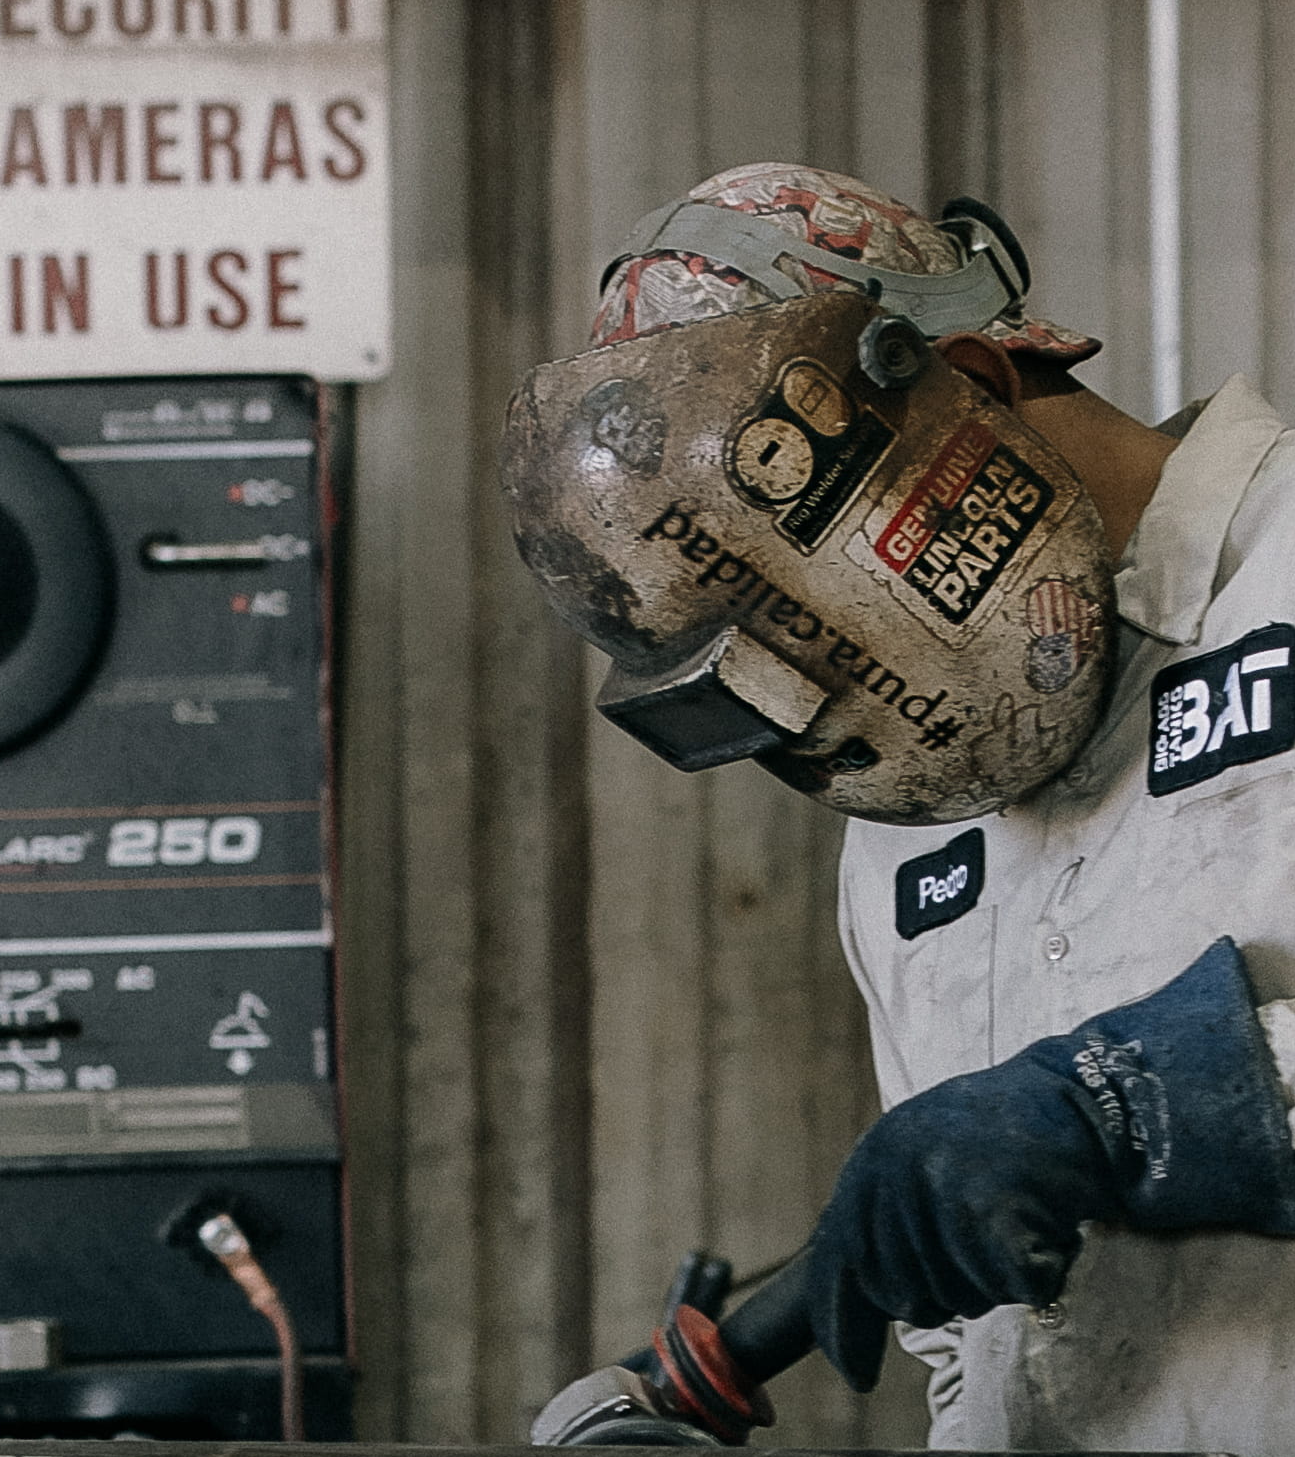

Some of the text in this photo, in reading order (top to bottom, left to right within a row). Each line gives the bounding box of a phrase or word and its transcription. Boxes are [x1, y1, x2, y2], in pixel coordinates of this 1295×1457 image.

[8, 249, 309, 334] IN USE
[786, 506, 812, 531] Rig
[803, 463, 844, 507] Welder
[933, 473, 1043, 613] PARTS
[640, 500, 961, 751] #pura.calidad
[106, 815, 264, 868] 250
